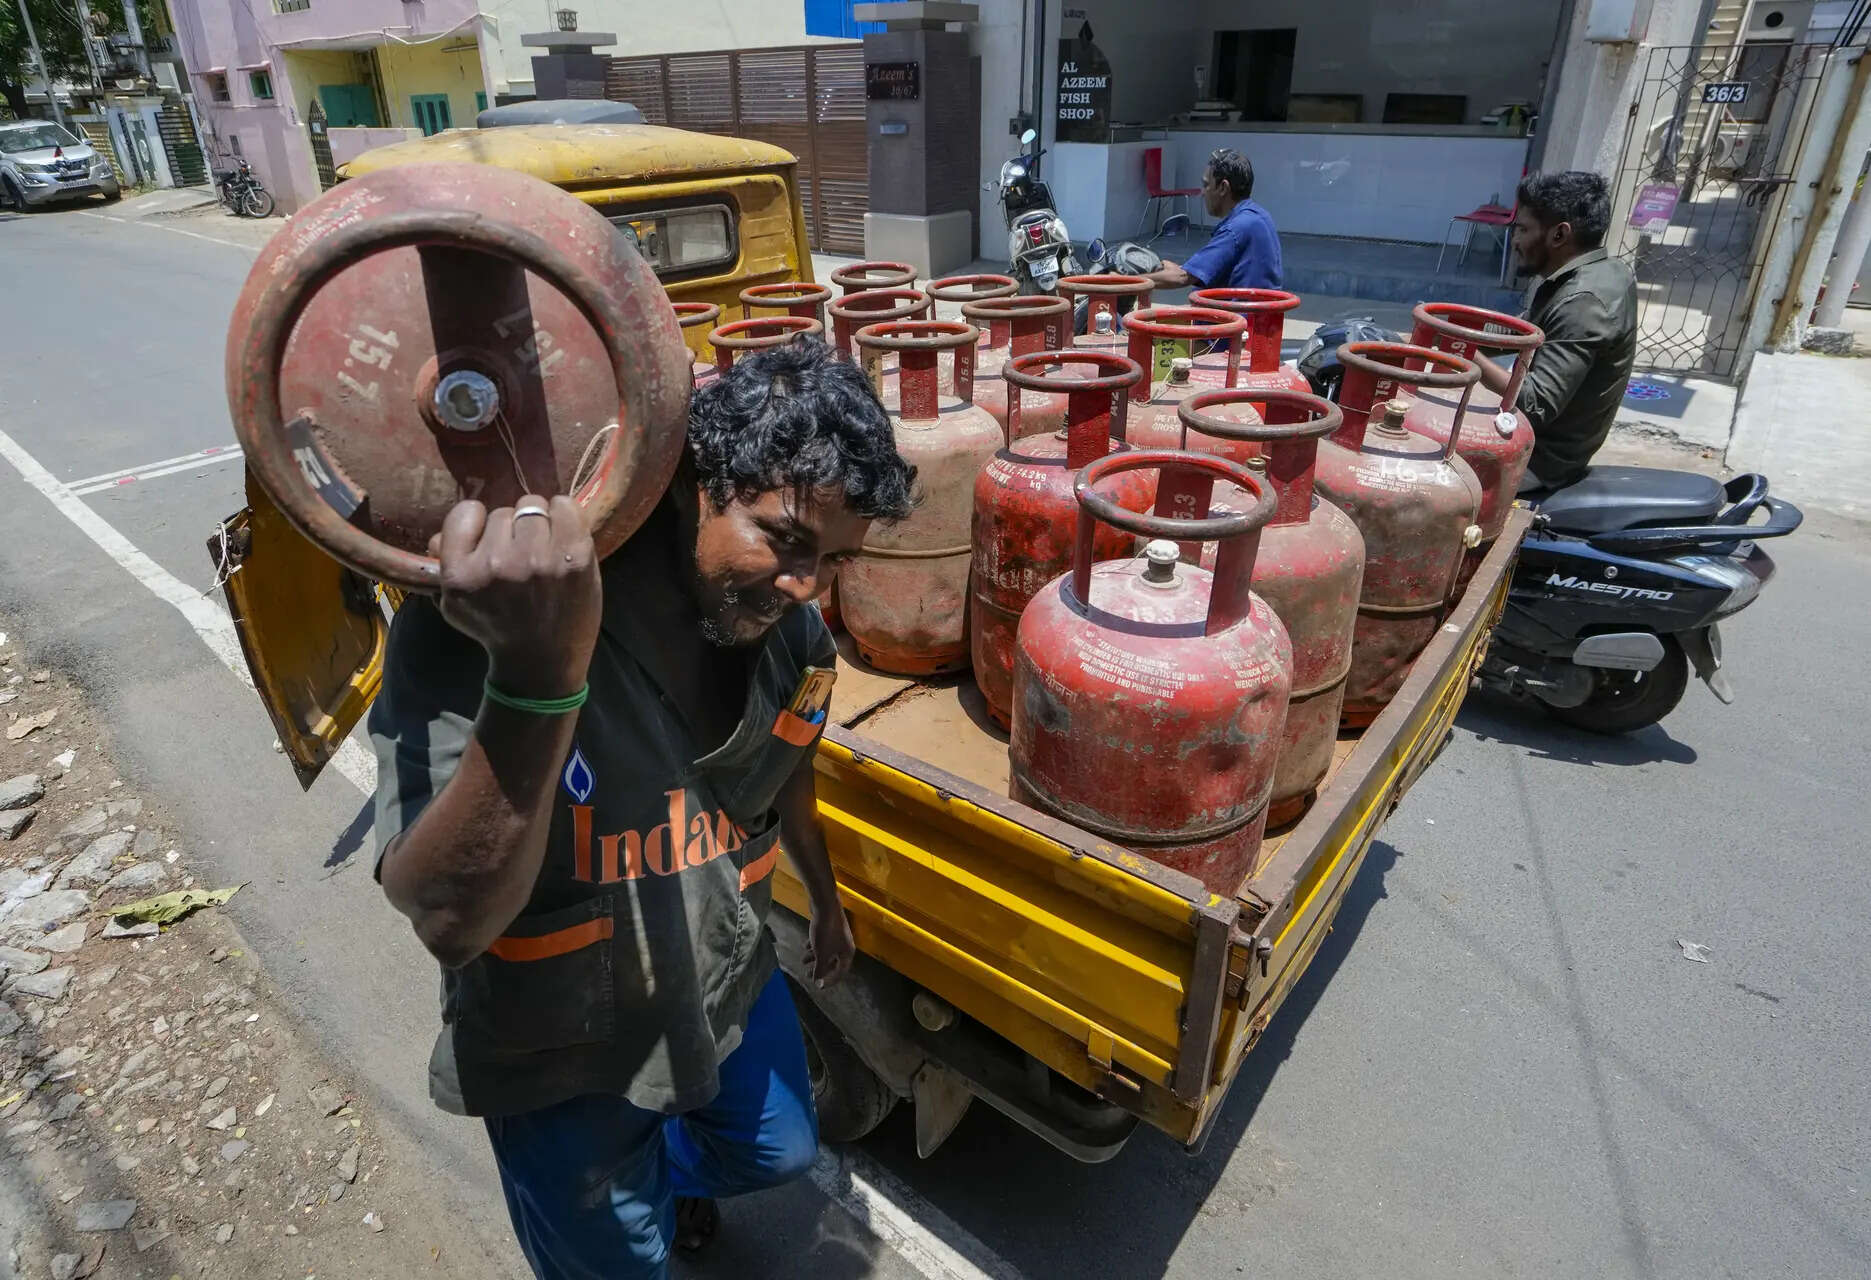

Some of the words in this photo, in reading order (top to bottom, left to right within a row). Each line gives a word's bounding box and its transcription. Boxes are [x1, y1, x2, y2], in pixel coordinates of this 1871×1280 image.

[1061, 62, 1078, 73] AL
[1061, 77, 1106, 88] AZEEM
[1060, 93, 1091, 104] FISH
[1706, 86, 1745, 102] 36/3
[1059, 108, 1095, 120] SHOP
[1545, 573, 1675, 601] MAESTRO
